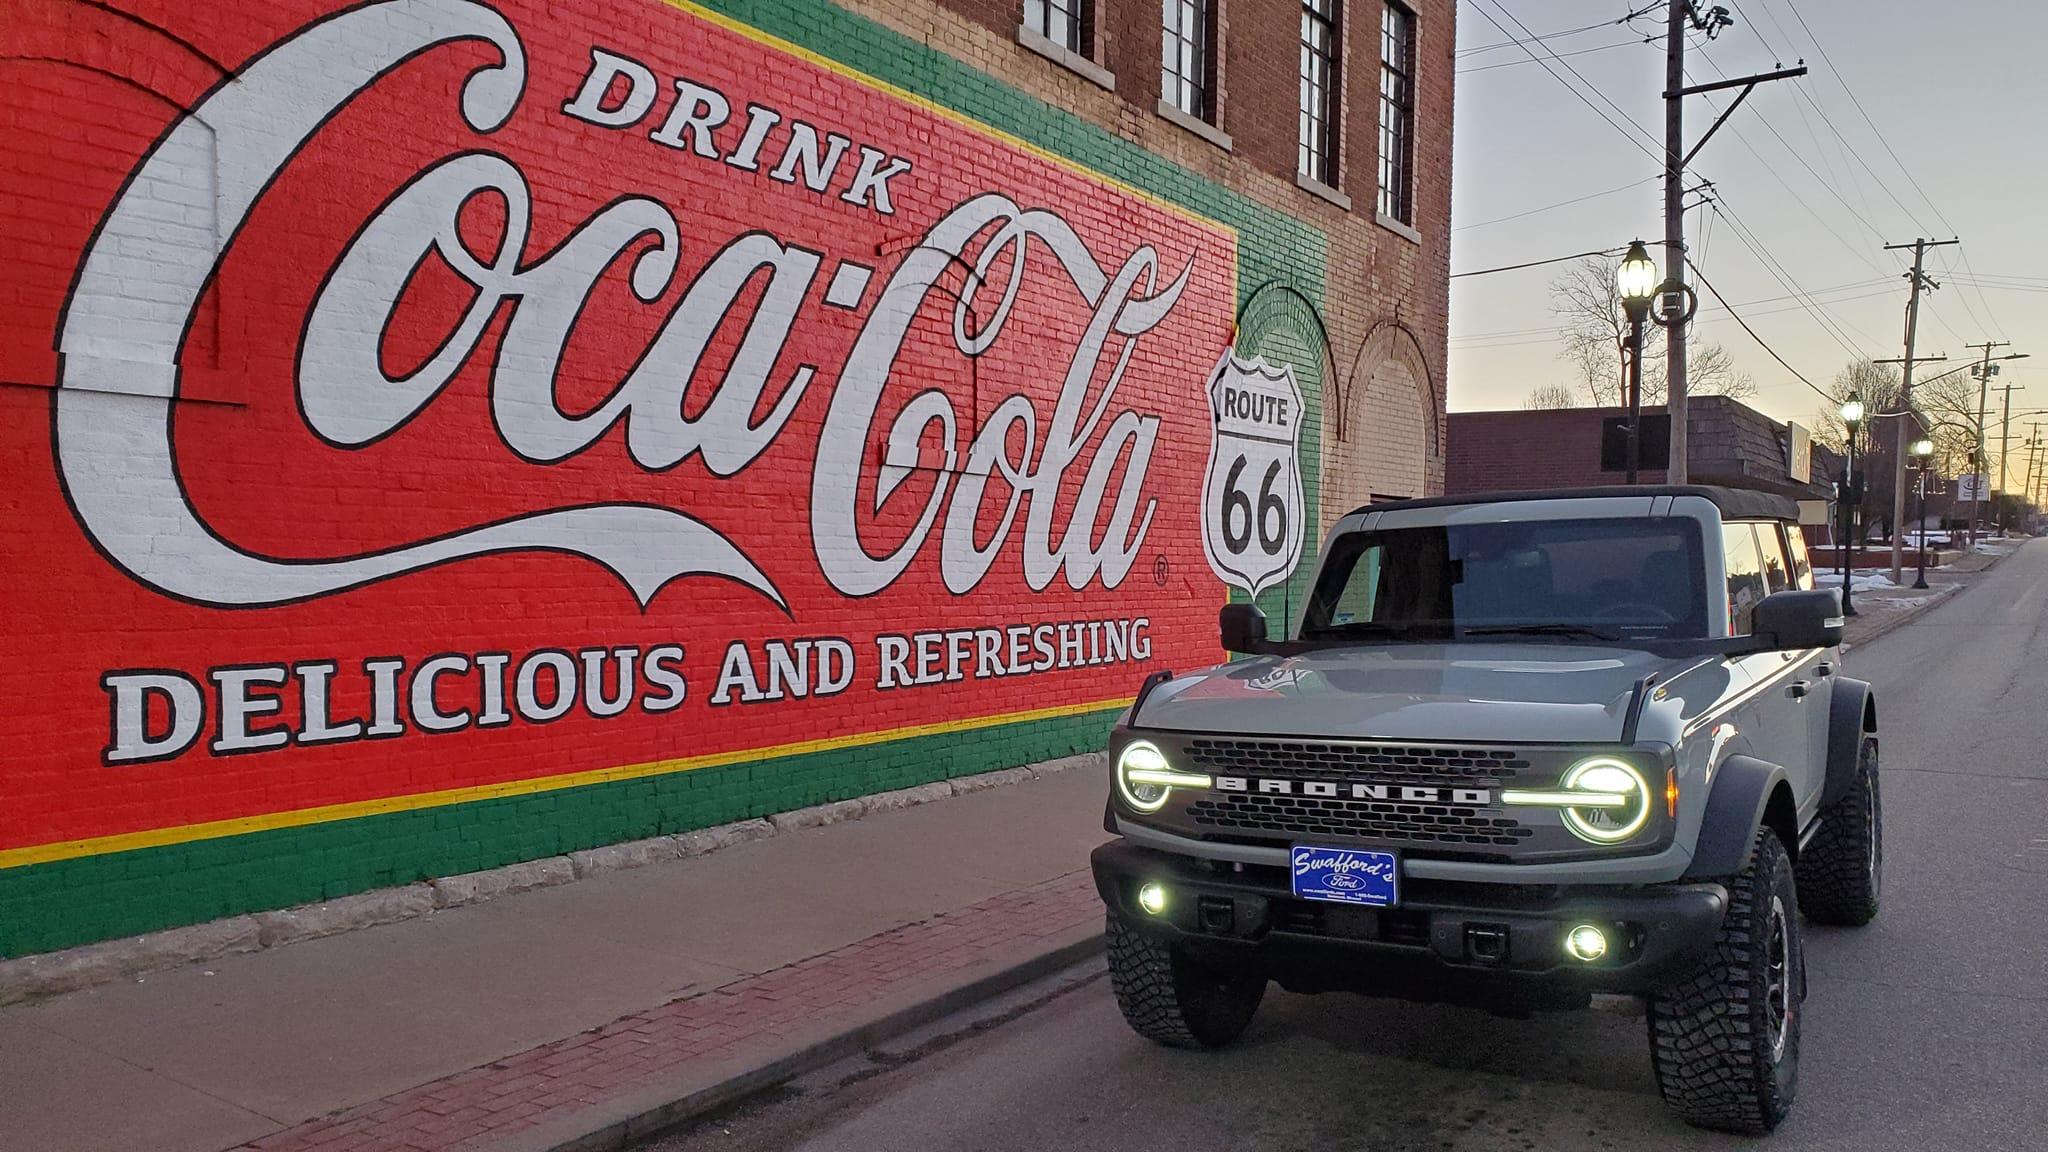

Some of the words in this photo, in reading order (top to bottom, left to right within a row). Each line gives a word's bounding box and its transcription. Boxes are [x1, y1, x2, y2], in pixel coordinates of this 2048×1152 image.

[563, 47, 912, 215] DRINK
[50, 0, 1198, 619] Coca-Cola
[1224, 387, 1288, 426] ROUTE
[1221, 453, 1287, 556] 66
[101, 644, 688, 767] DELICIOUS
[709, 636, 855, 706] AND
[875, 616, 1152, 689] REFRESHING
[1216, 776, 1491, 804] BRONCO
[1295, 853, 1393, 882] Swafford's
[1330, 875, 1358, 889] Ford
